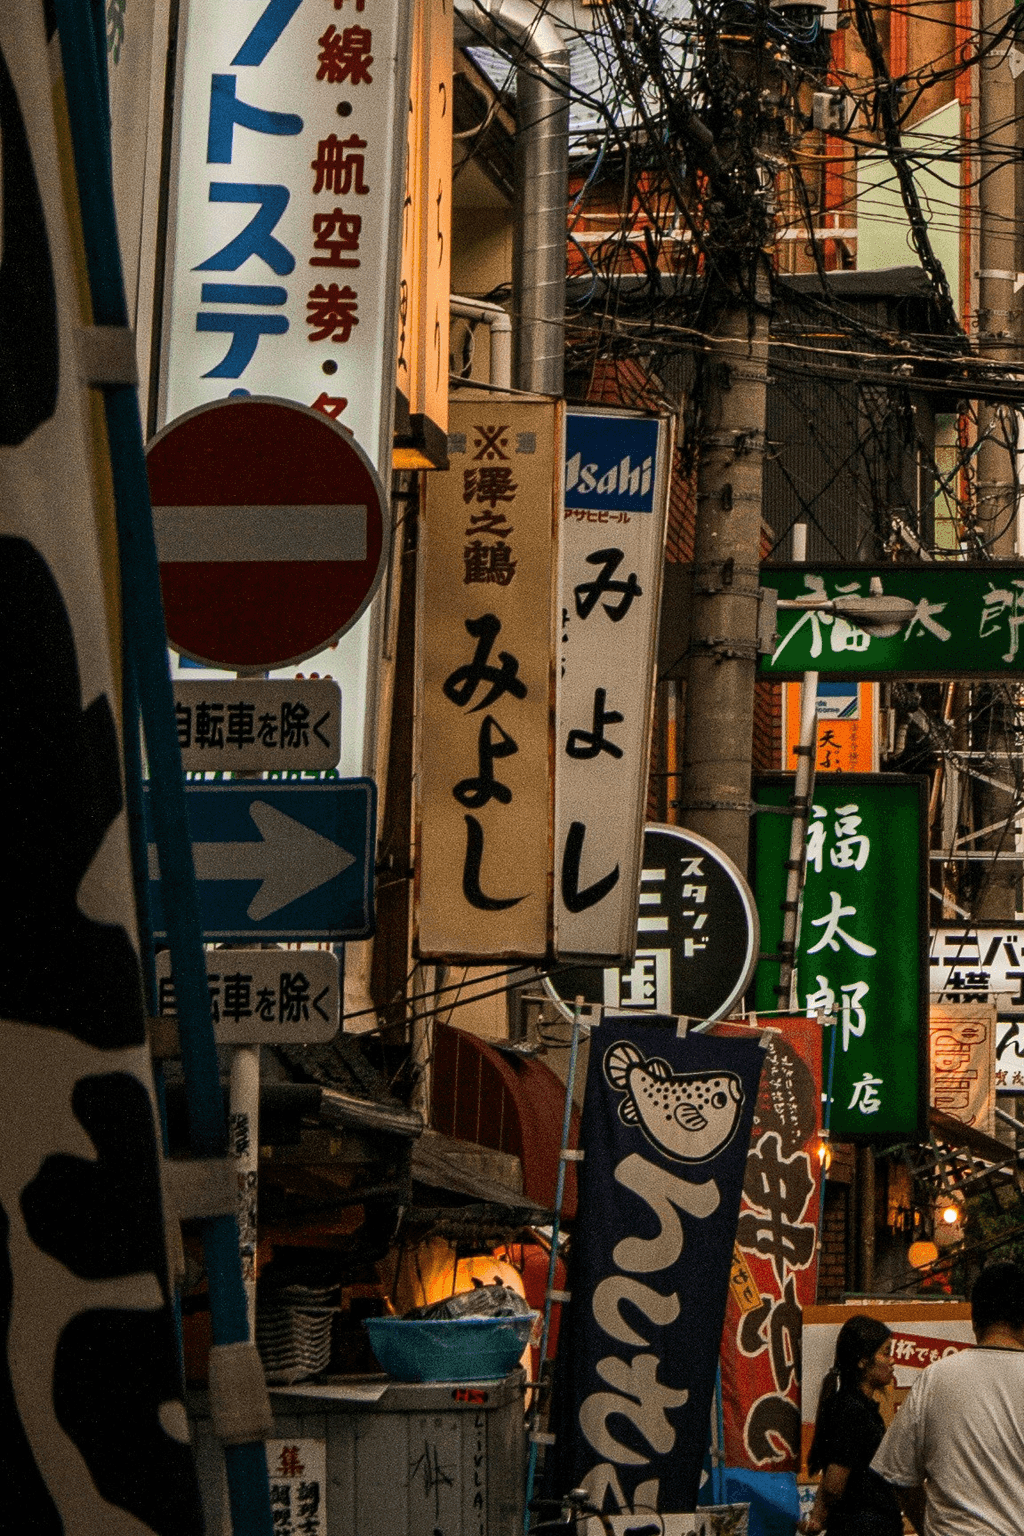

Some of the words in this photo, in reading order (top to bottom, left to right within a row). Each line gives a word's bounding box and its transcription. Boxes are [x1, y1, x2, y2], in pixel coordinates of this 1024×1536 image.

[564, 510, 631, 524] アサヒビール
[566, 451, 653, 496] Asahi
[173, 701, 331, 749] 自転車を除く
[443, 614, 532, 911] みよし
[562, 548, 642, 913] みよし
[680, 857, 709, 958] スタンド
[806, 804, 877, 1052] 福太郎
